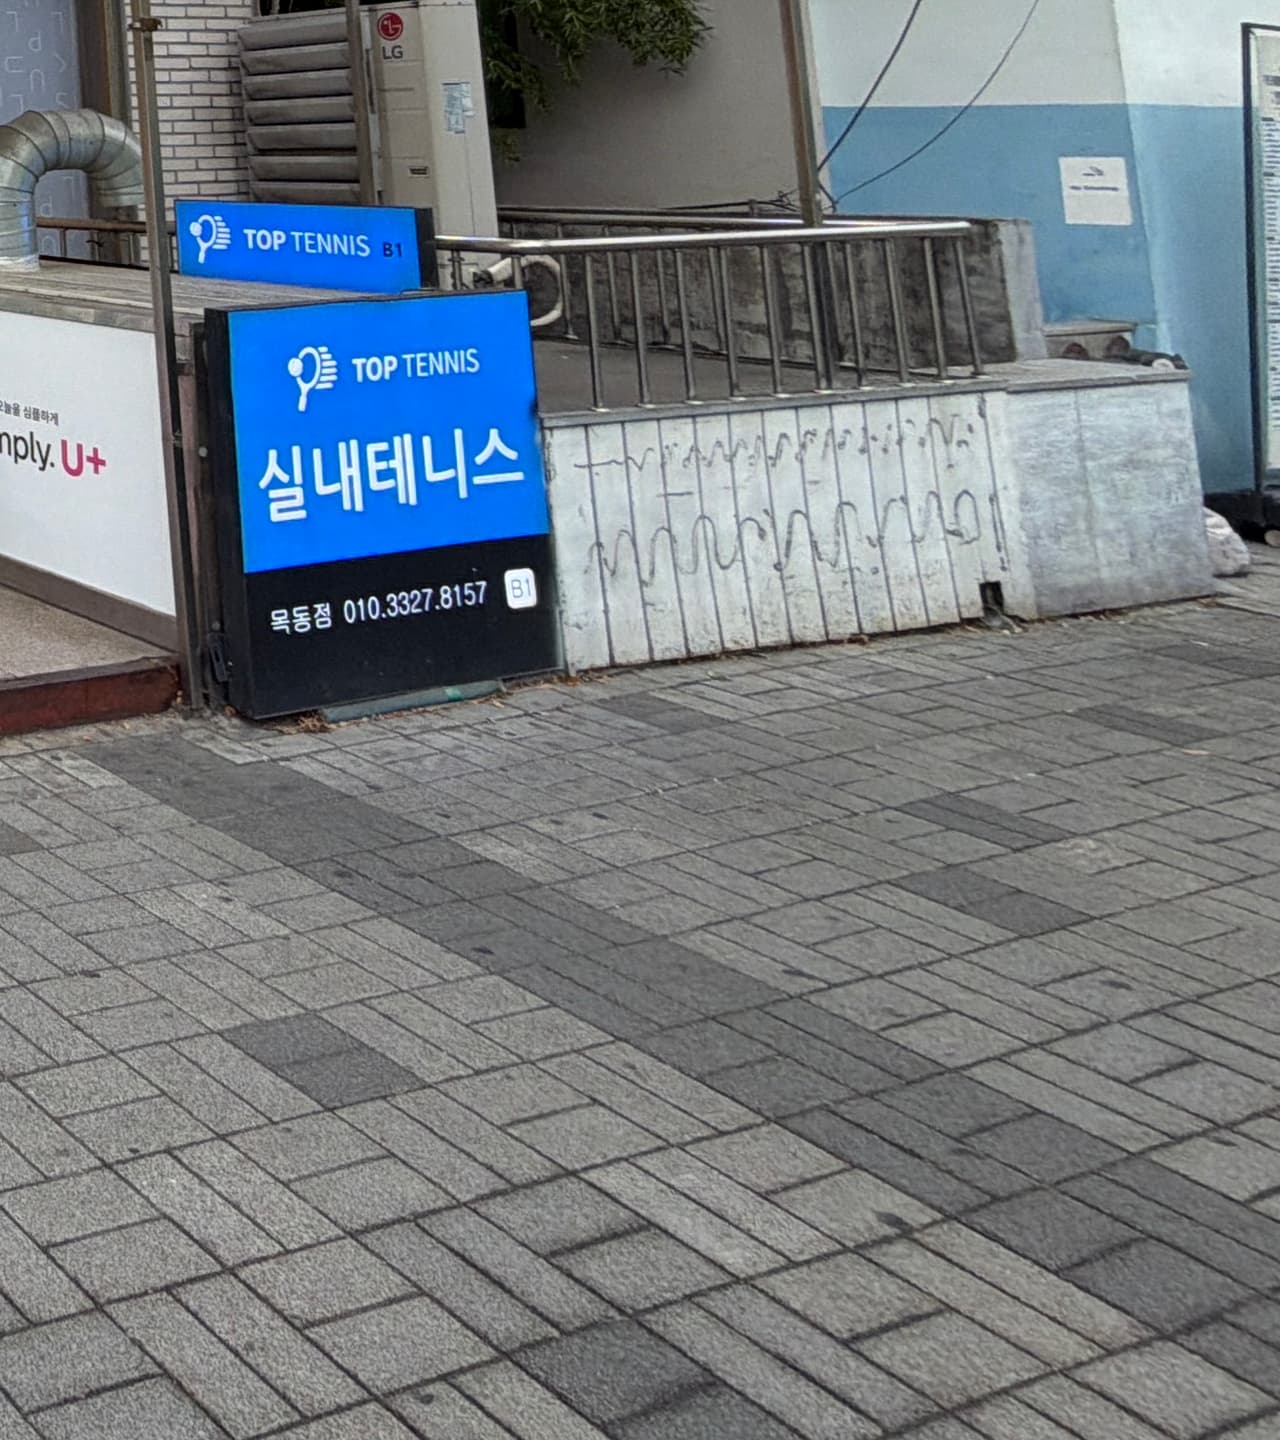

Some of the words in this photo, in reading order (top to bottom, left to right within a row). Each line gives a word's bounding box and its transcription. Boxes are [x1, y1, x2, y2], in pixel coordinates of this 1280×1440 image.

[382, 44, 404, 60] LG
[243, 228, 286, 252] TOP
[291, 230, 371, 258] TENNIS
[382, 241, 403, 259] B1
[352, 355, 399, 383] TOP
[403, 347, 481, 378] TENNIS
[23, 405, 60, 427] 심플하게
[60, 438, 107, 478] U+
[258, 426, 526, 524] 실내테니스
[510, 576, 533, 599] B1
[270, 600, 333, 636] 목동점
[343, 580, 488, 625] 010.3327.8157
